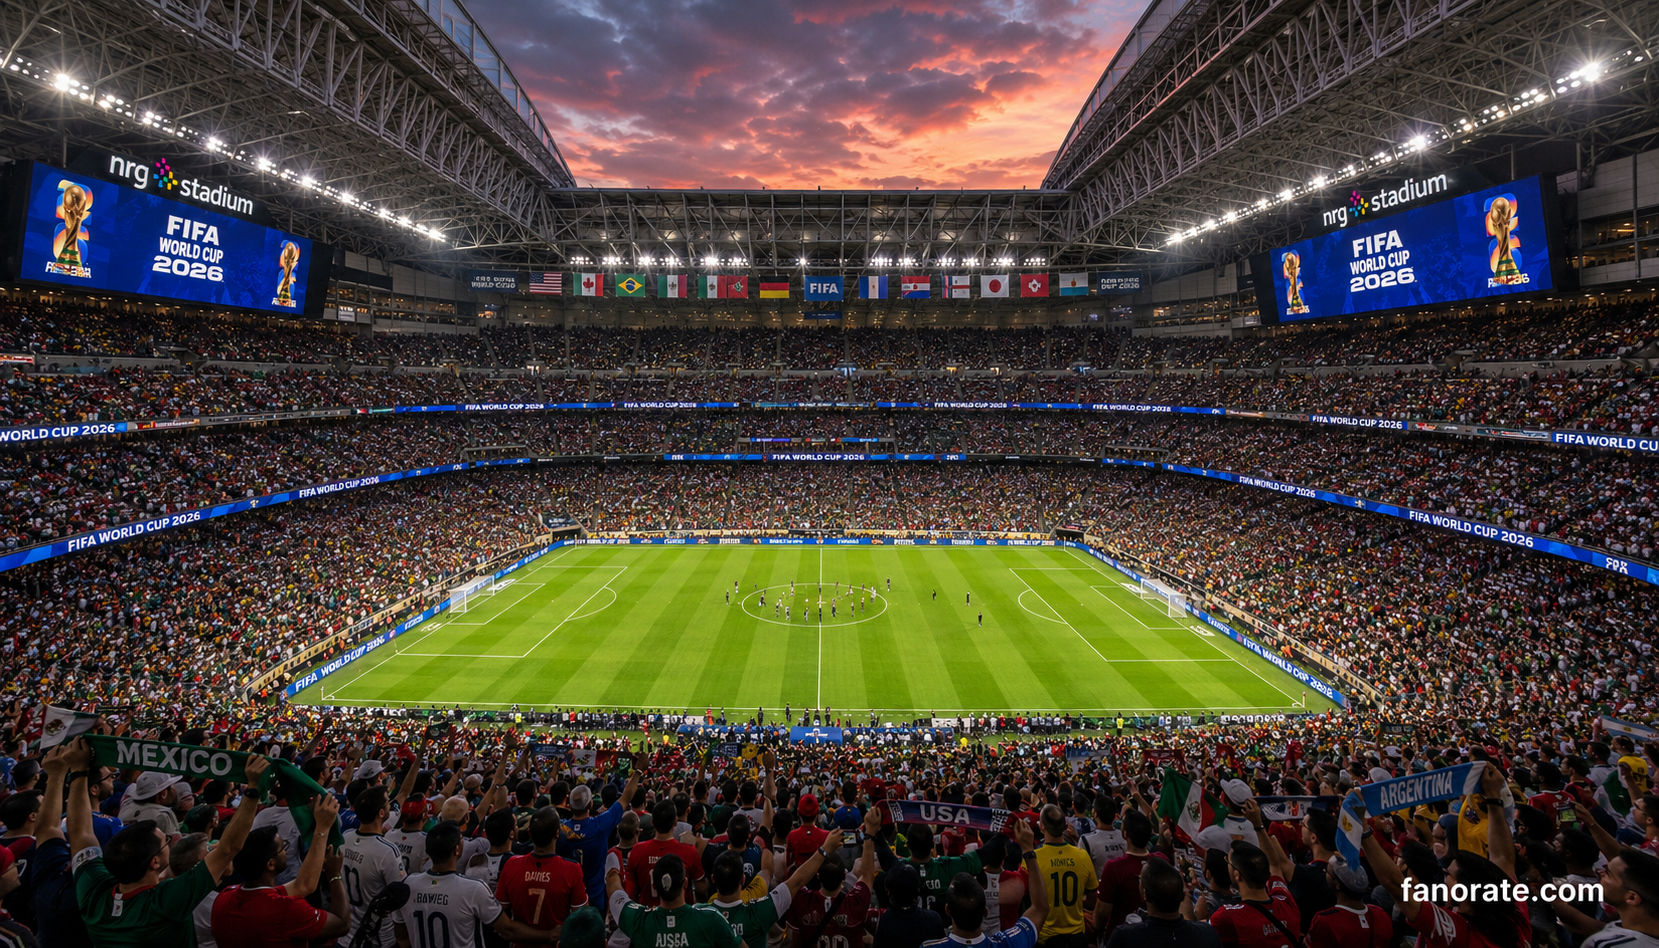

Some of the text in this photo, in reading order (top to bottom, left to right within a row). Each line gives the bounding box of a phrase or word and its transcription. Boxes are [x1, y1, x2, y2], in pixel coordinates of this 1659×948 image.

[109, 155, 254, 215] nrg stadium
[1323, 174, 1448, 228] nrg stadium
[166, 214, 220, 246] FIFA
[1352, 229, 1404, 258] FIFA
[159, 236, 224, 264] WORLD CUP
[1349, 250, 1410, 275] WORLD CUP
[809, 283, 839, 294] FIFA
[0, 423, 115, 442] WORLD CUP 2026
[1312, 415, 1328, 423] FIFA
[1329, 417, 1358, 426] WORLD
[1359, 419, 1377, 427] CUP
[1378, 420, 1403, 429] 2026
[1555, 433, 1659, 451] FIFA WORLD CU
[299, 488, 316, 499] FIFA
[316, 482, 344, 495] WORLD
[345, 478, 360, 489] CUP
[1239, 475, 1316, 498] FIFA WORLD CUP 2026
[68, 511, 201, 552] FIFA WORLD CUP 2026
[1409, 510, 1534, 548] FIFA WORLD CUP 2026
[295, 672, 318, 692] FIFA
[116, 740, 233, 776] MEXICO
[1380, 770, 1454, 810] ARGENTINA
[919, 803, 970, 825] USA
[1050, 871, 1078, 907] 10
[528, 887, 546, 925] 7
[413, 910, 450, 948] 10
